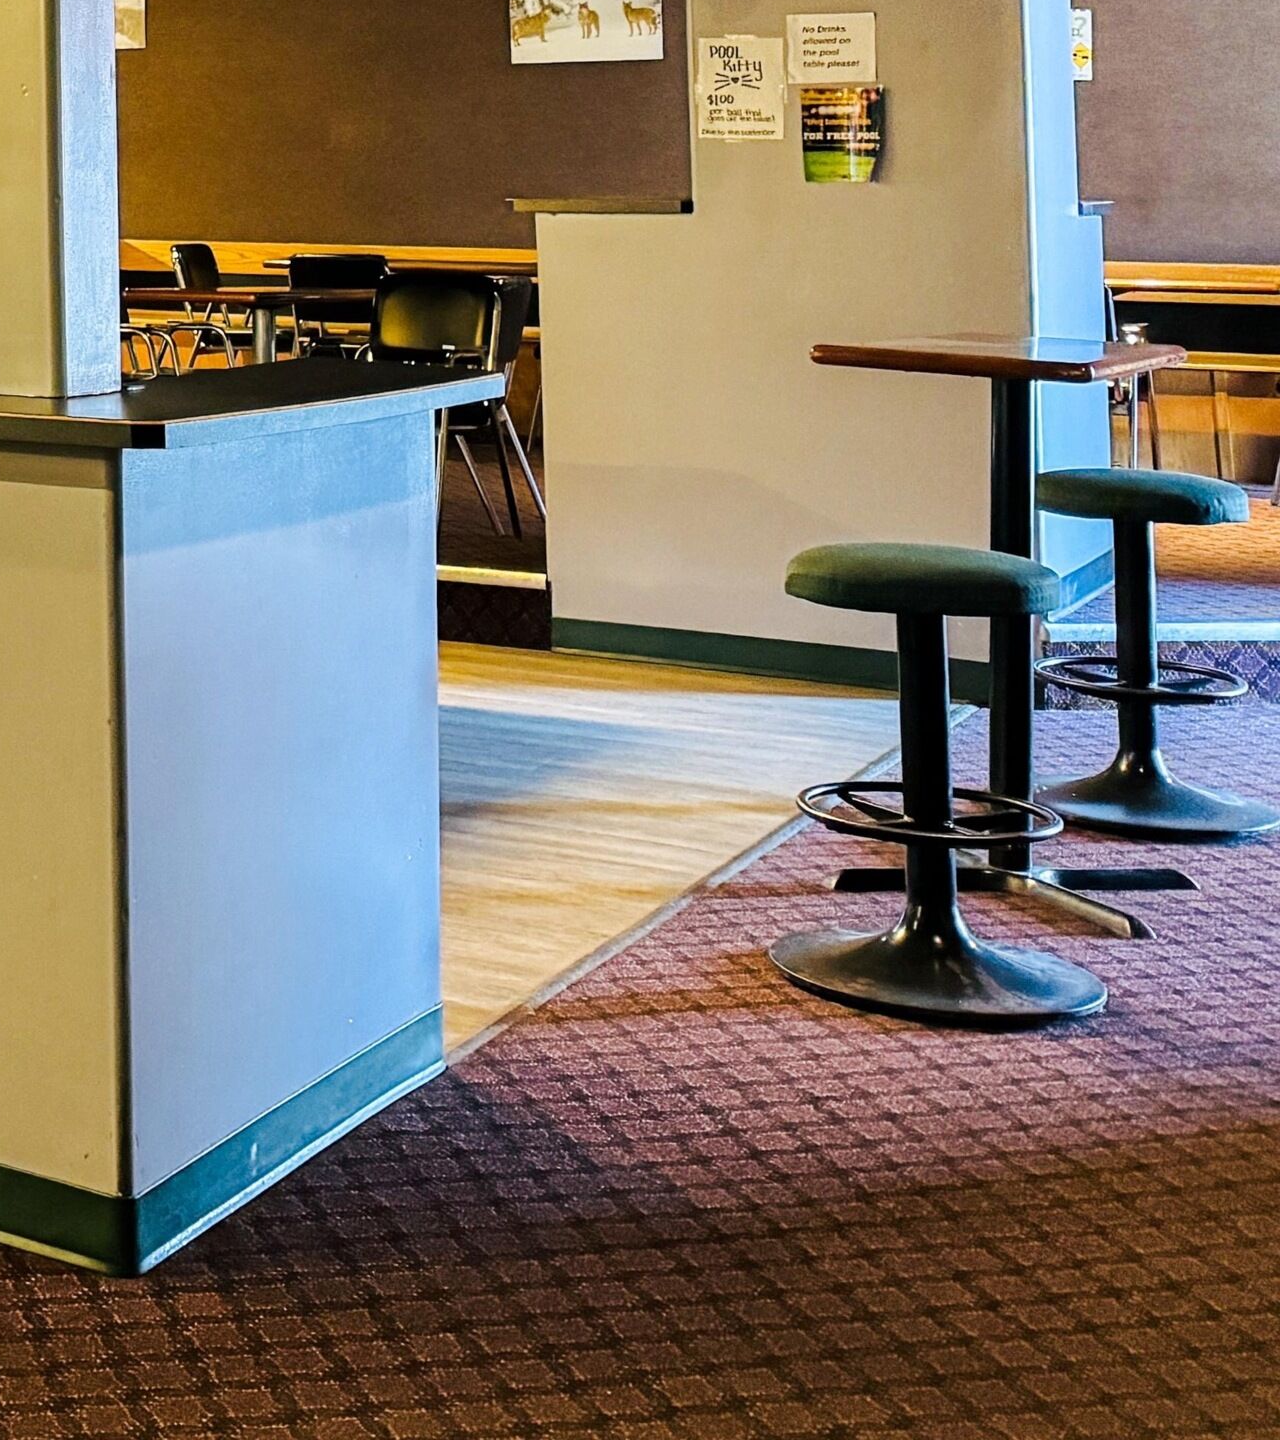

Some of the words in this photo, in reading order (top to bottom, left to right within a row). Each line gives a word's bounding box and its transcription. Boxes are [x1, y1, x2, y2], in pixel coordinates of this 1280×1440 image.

[817, 25, 847, 33] Drinks
[802, 37, 838, 45] allowed
[709, 45, 743, 59] POOL
[819, 48, 840, 57] pool
[803, 60, 826, 68] table
[827, 60, 860, 69] please!
[723, 59, 763, 82] Kitty
[803, 131, 824, 140] FOR
[826, 131, 855, 140] FREE
[856, 131, 881, 140] POOL
